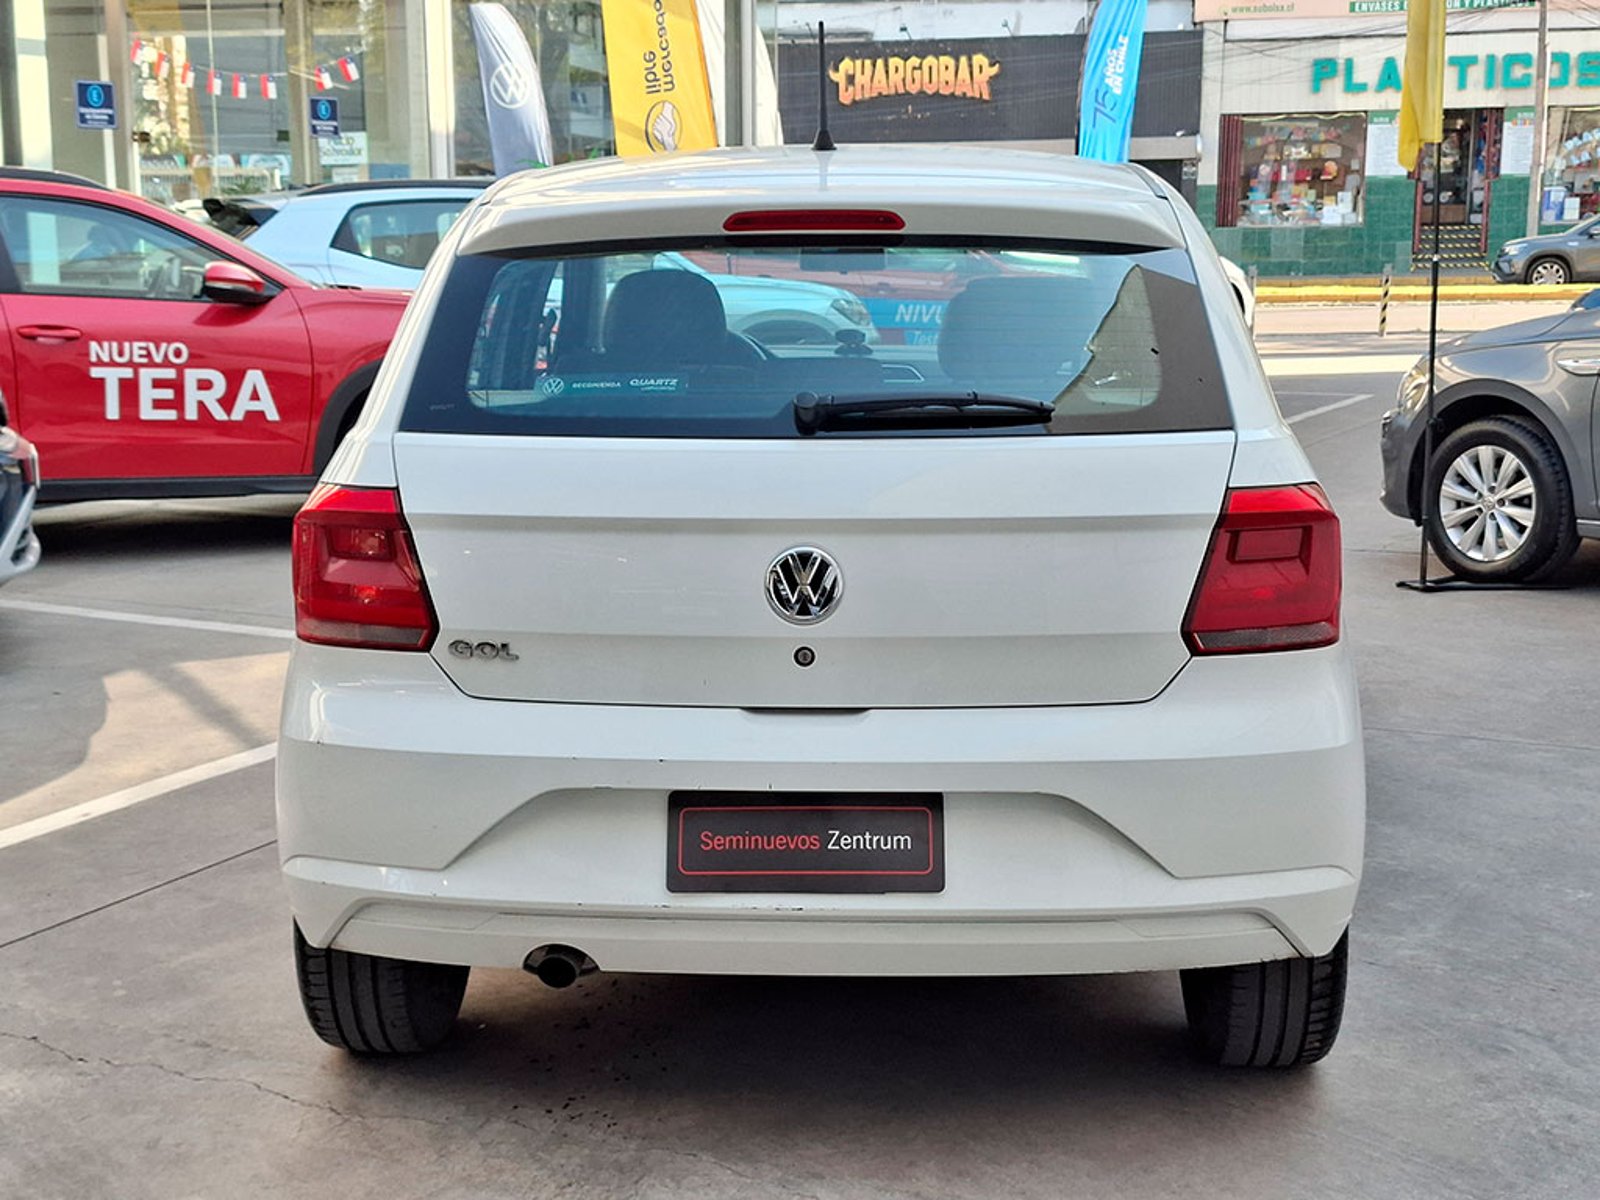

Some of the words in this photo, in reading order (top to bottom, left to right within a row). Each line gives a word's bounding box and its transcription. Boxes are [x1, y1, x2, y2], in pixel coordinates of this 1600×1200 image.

[828, 52, 1000, 106] CHARGOBAR
[1311, 51, 1600, 94] PLATICOS
[1092, 88, 1117, 129] 75
[89, 340, 189, 364] NUEVO
[89, 367, 280, 421] TERA
[629, 378, 679, 387] QUARTZ
[448, 639, 520, 663] GOL
[700, 830, 820, 851] Seminuevos
[827, 830, 912, 851] Zentrum
